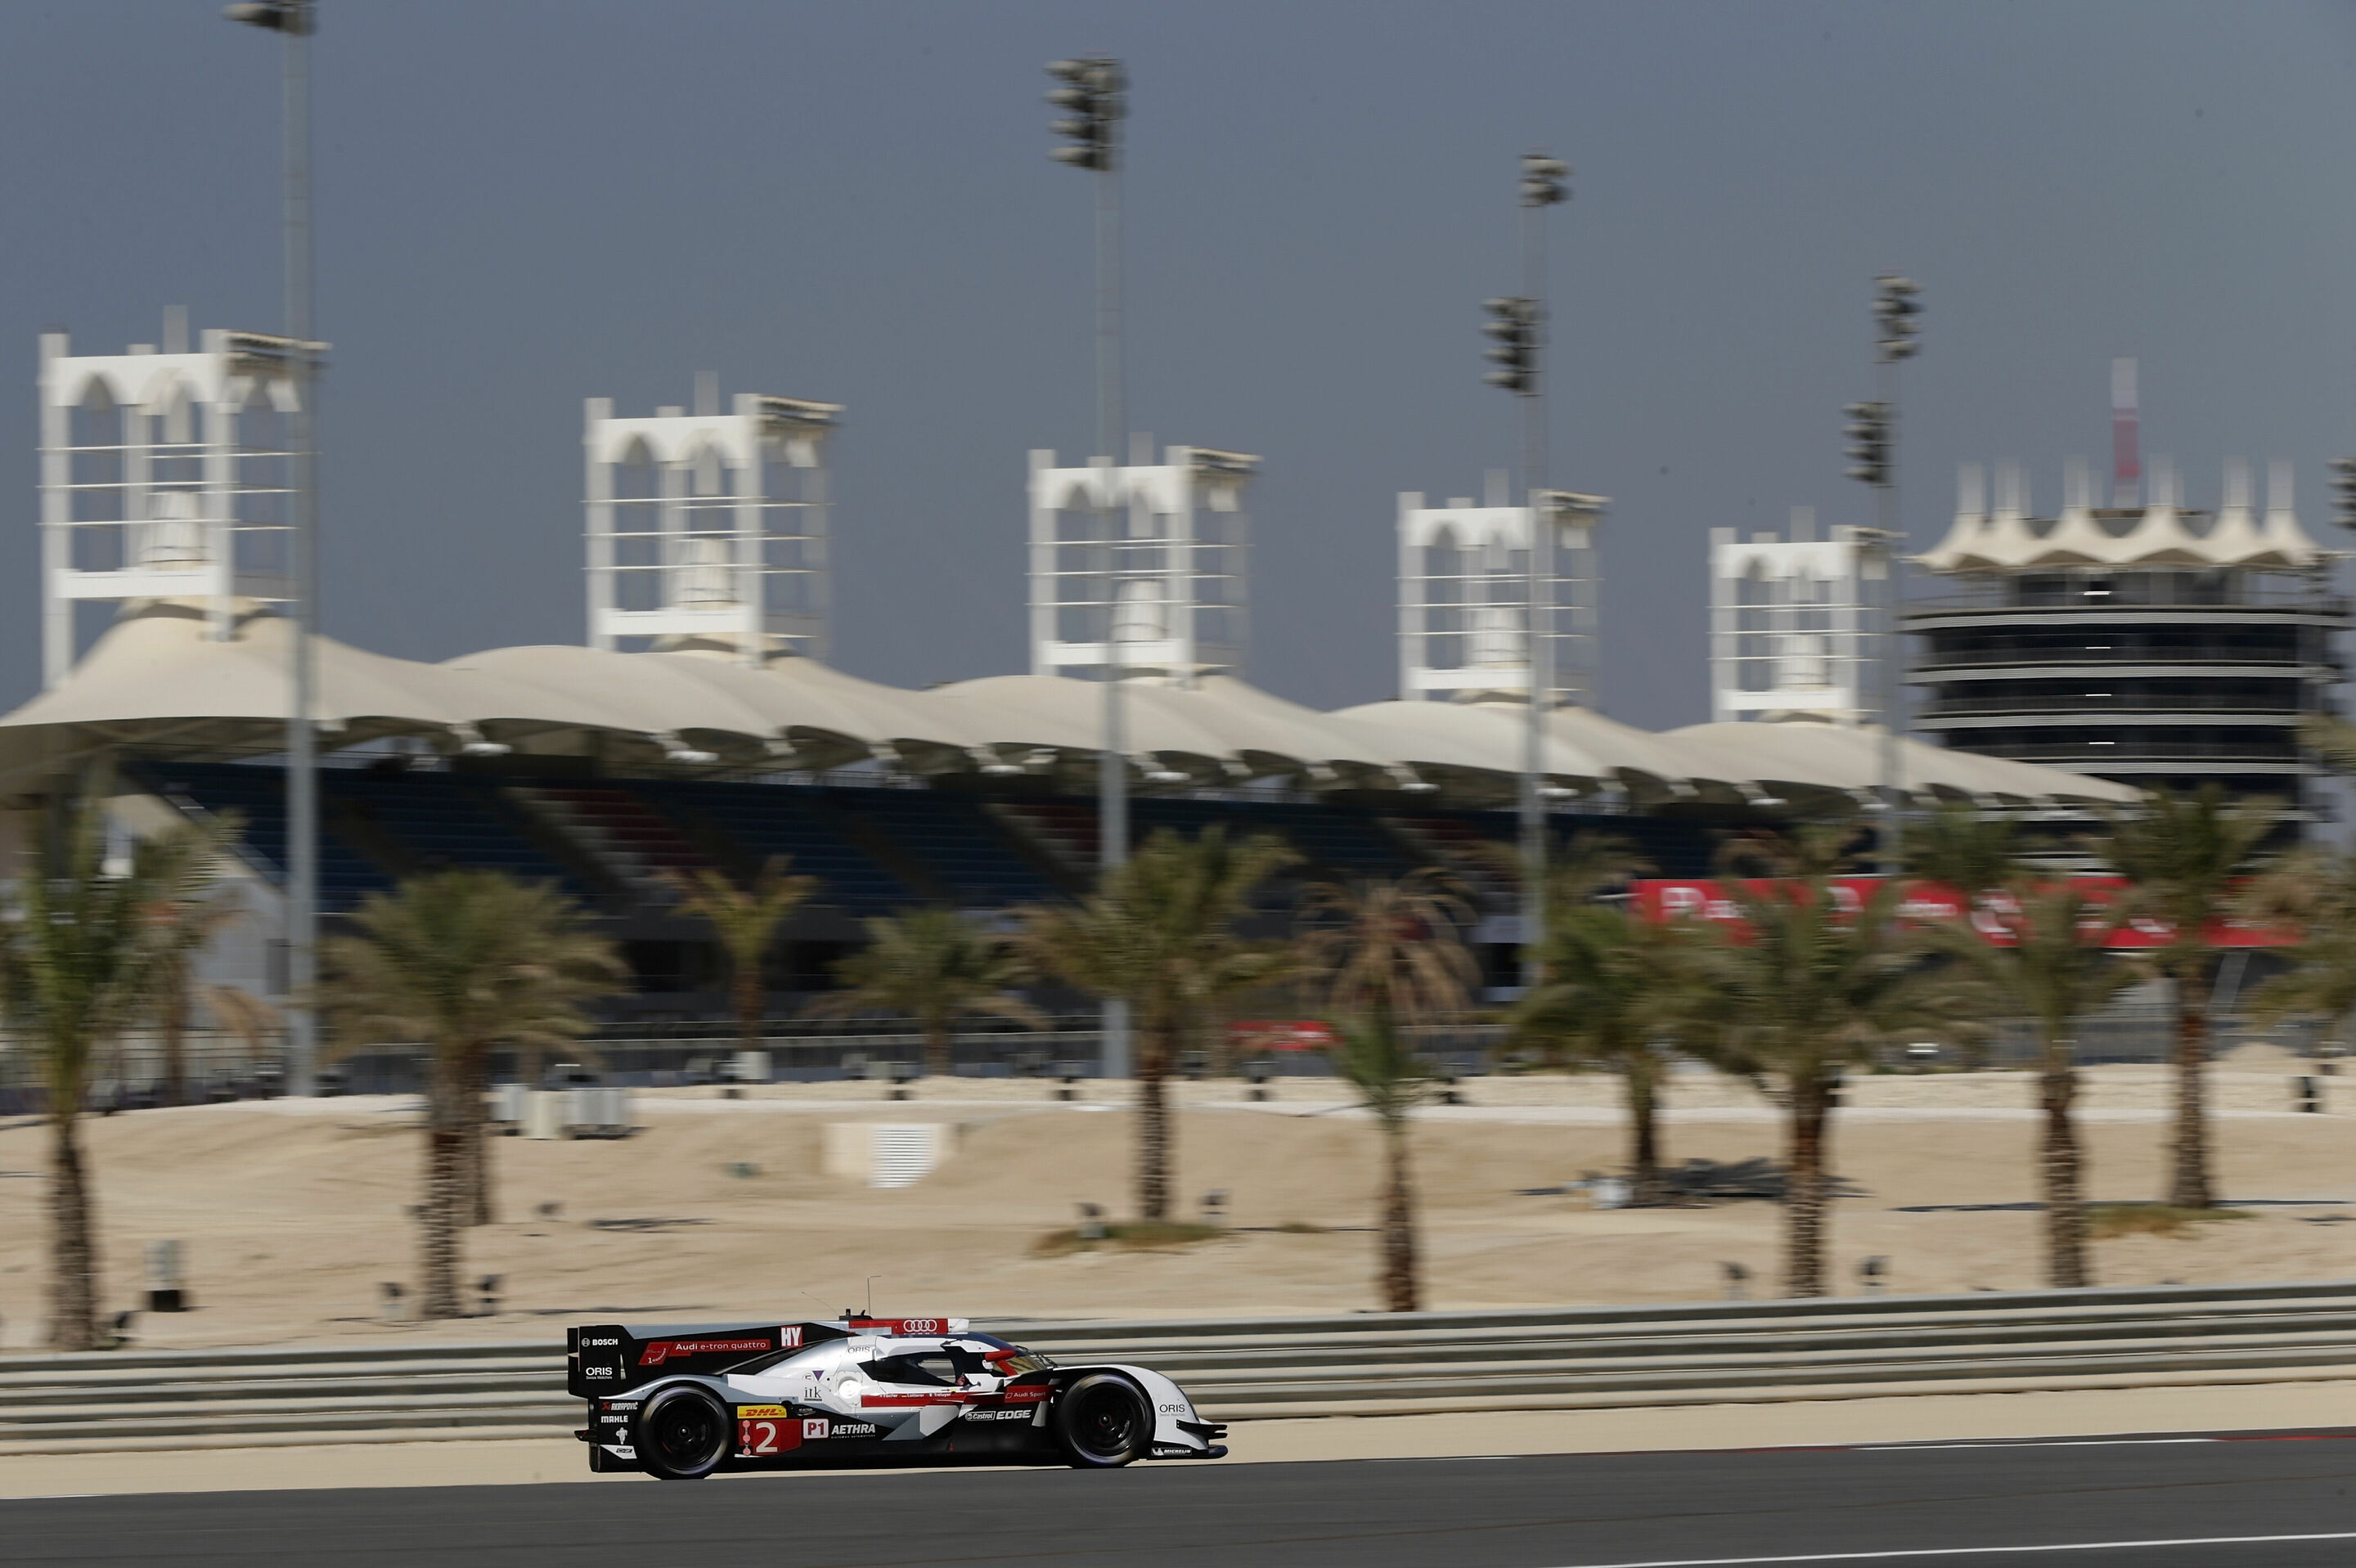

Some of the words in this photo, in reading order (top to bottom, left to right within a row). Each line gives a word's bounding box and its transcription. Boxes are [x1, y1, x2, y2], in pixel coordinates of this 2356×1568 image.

[781, 1328, 801, 1346] HY
[731, 1341, 767, 1350] quattro
[586, 1368, 613, 1376] ORIS
[804, 1386, 822, 1398] itk
[745, 1409, 779, 1417] DHL
[1159, 1404, 1185, 1413] ORIS
[600, 1415, 628, 1423] MAHLE
[996, 1410, 1032, 1420] EDGE
[807, 1422, 825, 1435] P1
[831, 1424, 876, 1435] AETHRA
[755, 1422, 778, 1453] 2
